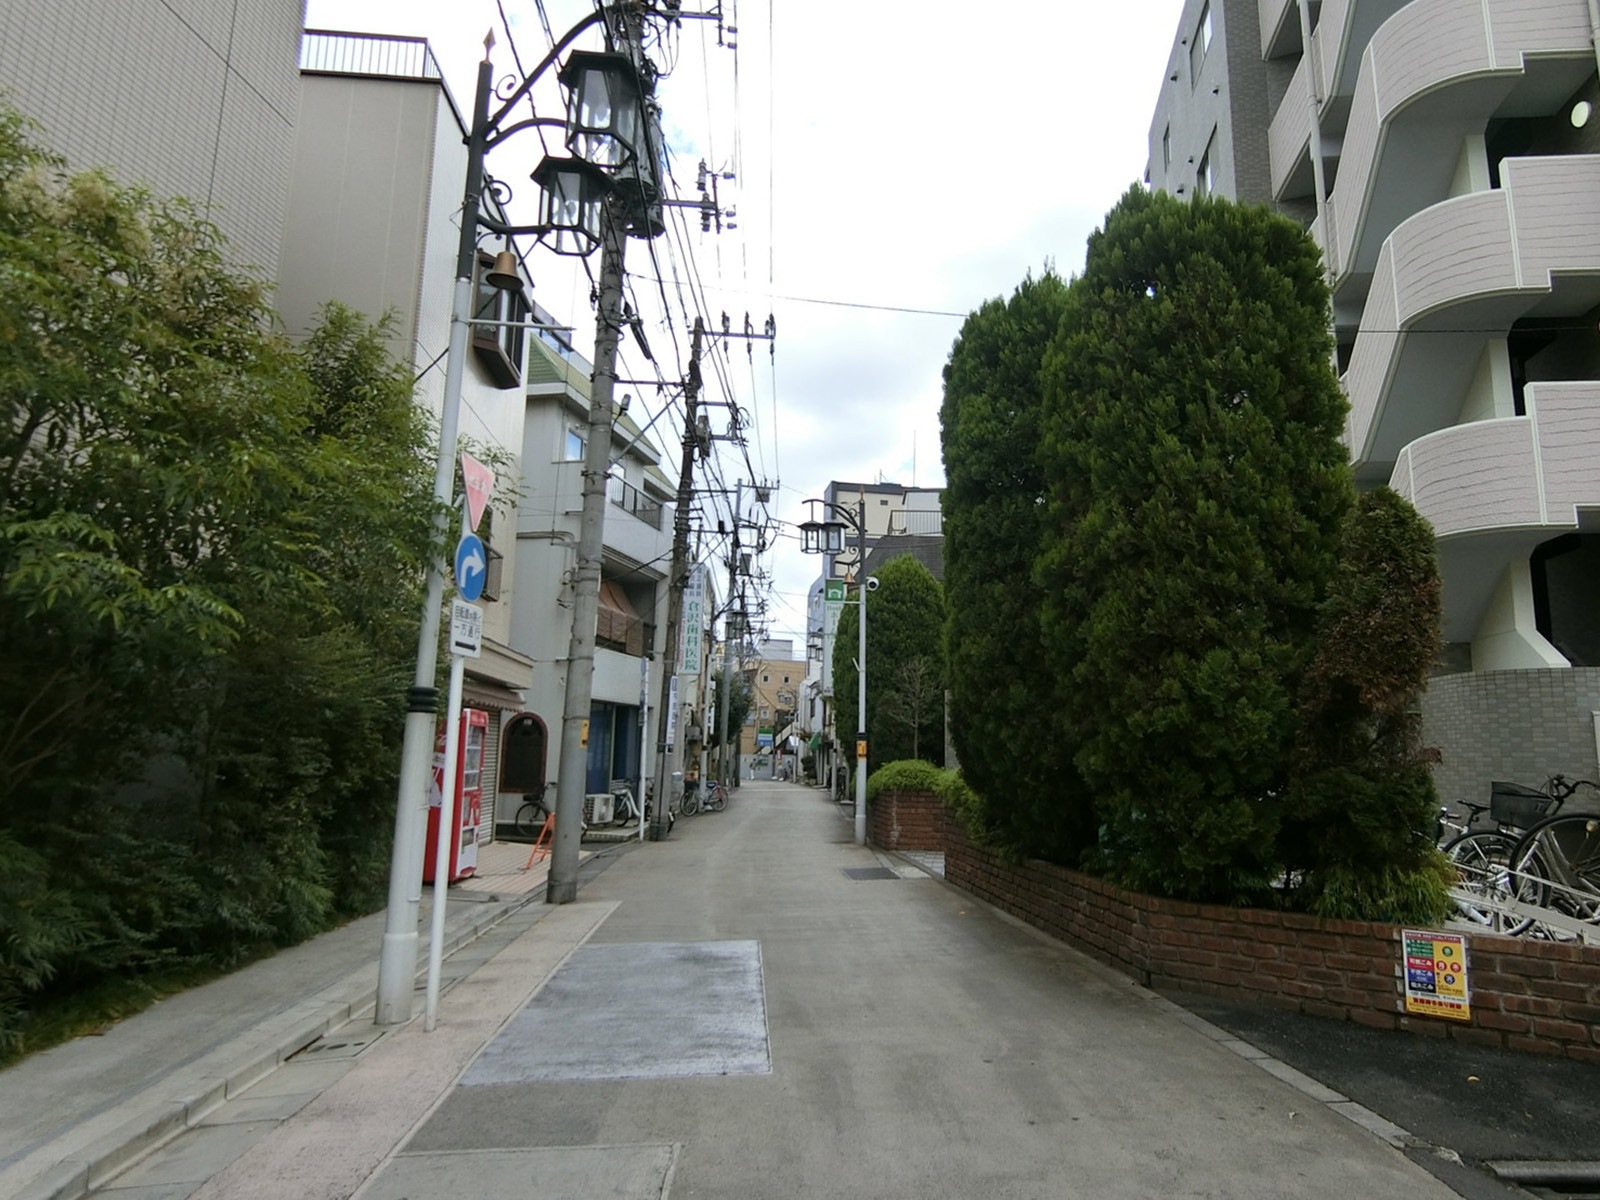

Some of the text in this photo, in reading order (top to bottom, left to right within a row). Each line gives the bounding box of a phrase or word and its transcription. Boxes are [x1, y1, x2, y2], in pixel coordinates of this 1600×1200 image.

[455, 604, 481, 623] 自転車を除く
[454, 624, 480, 640] 一方通行
[685, 600, 700, 670] 倉沢歯科医院
